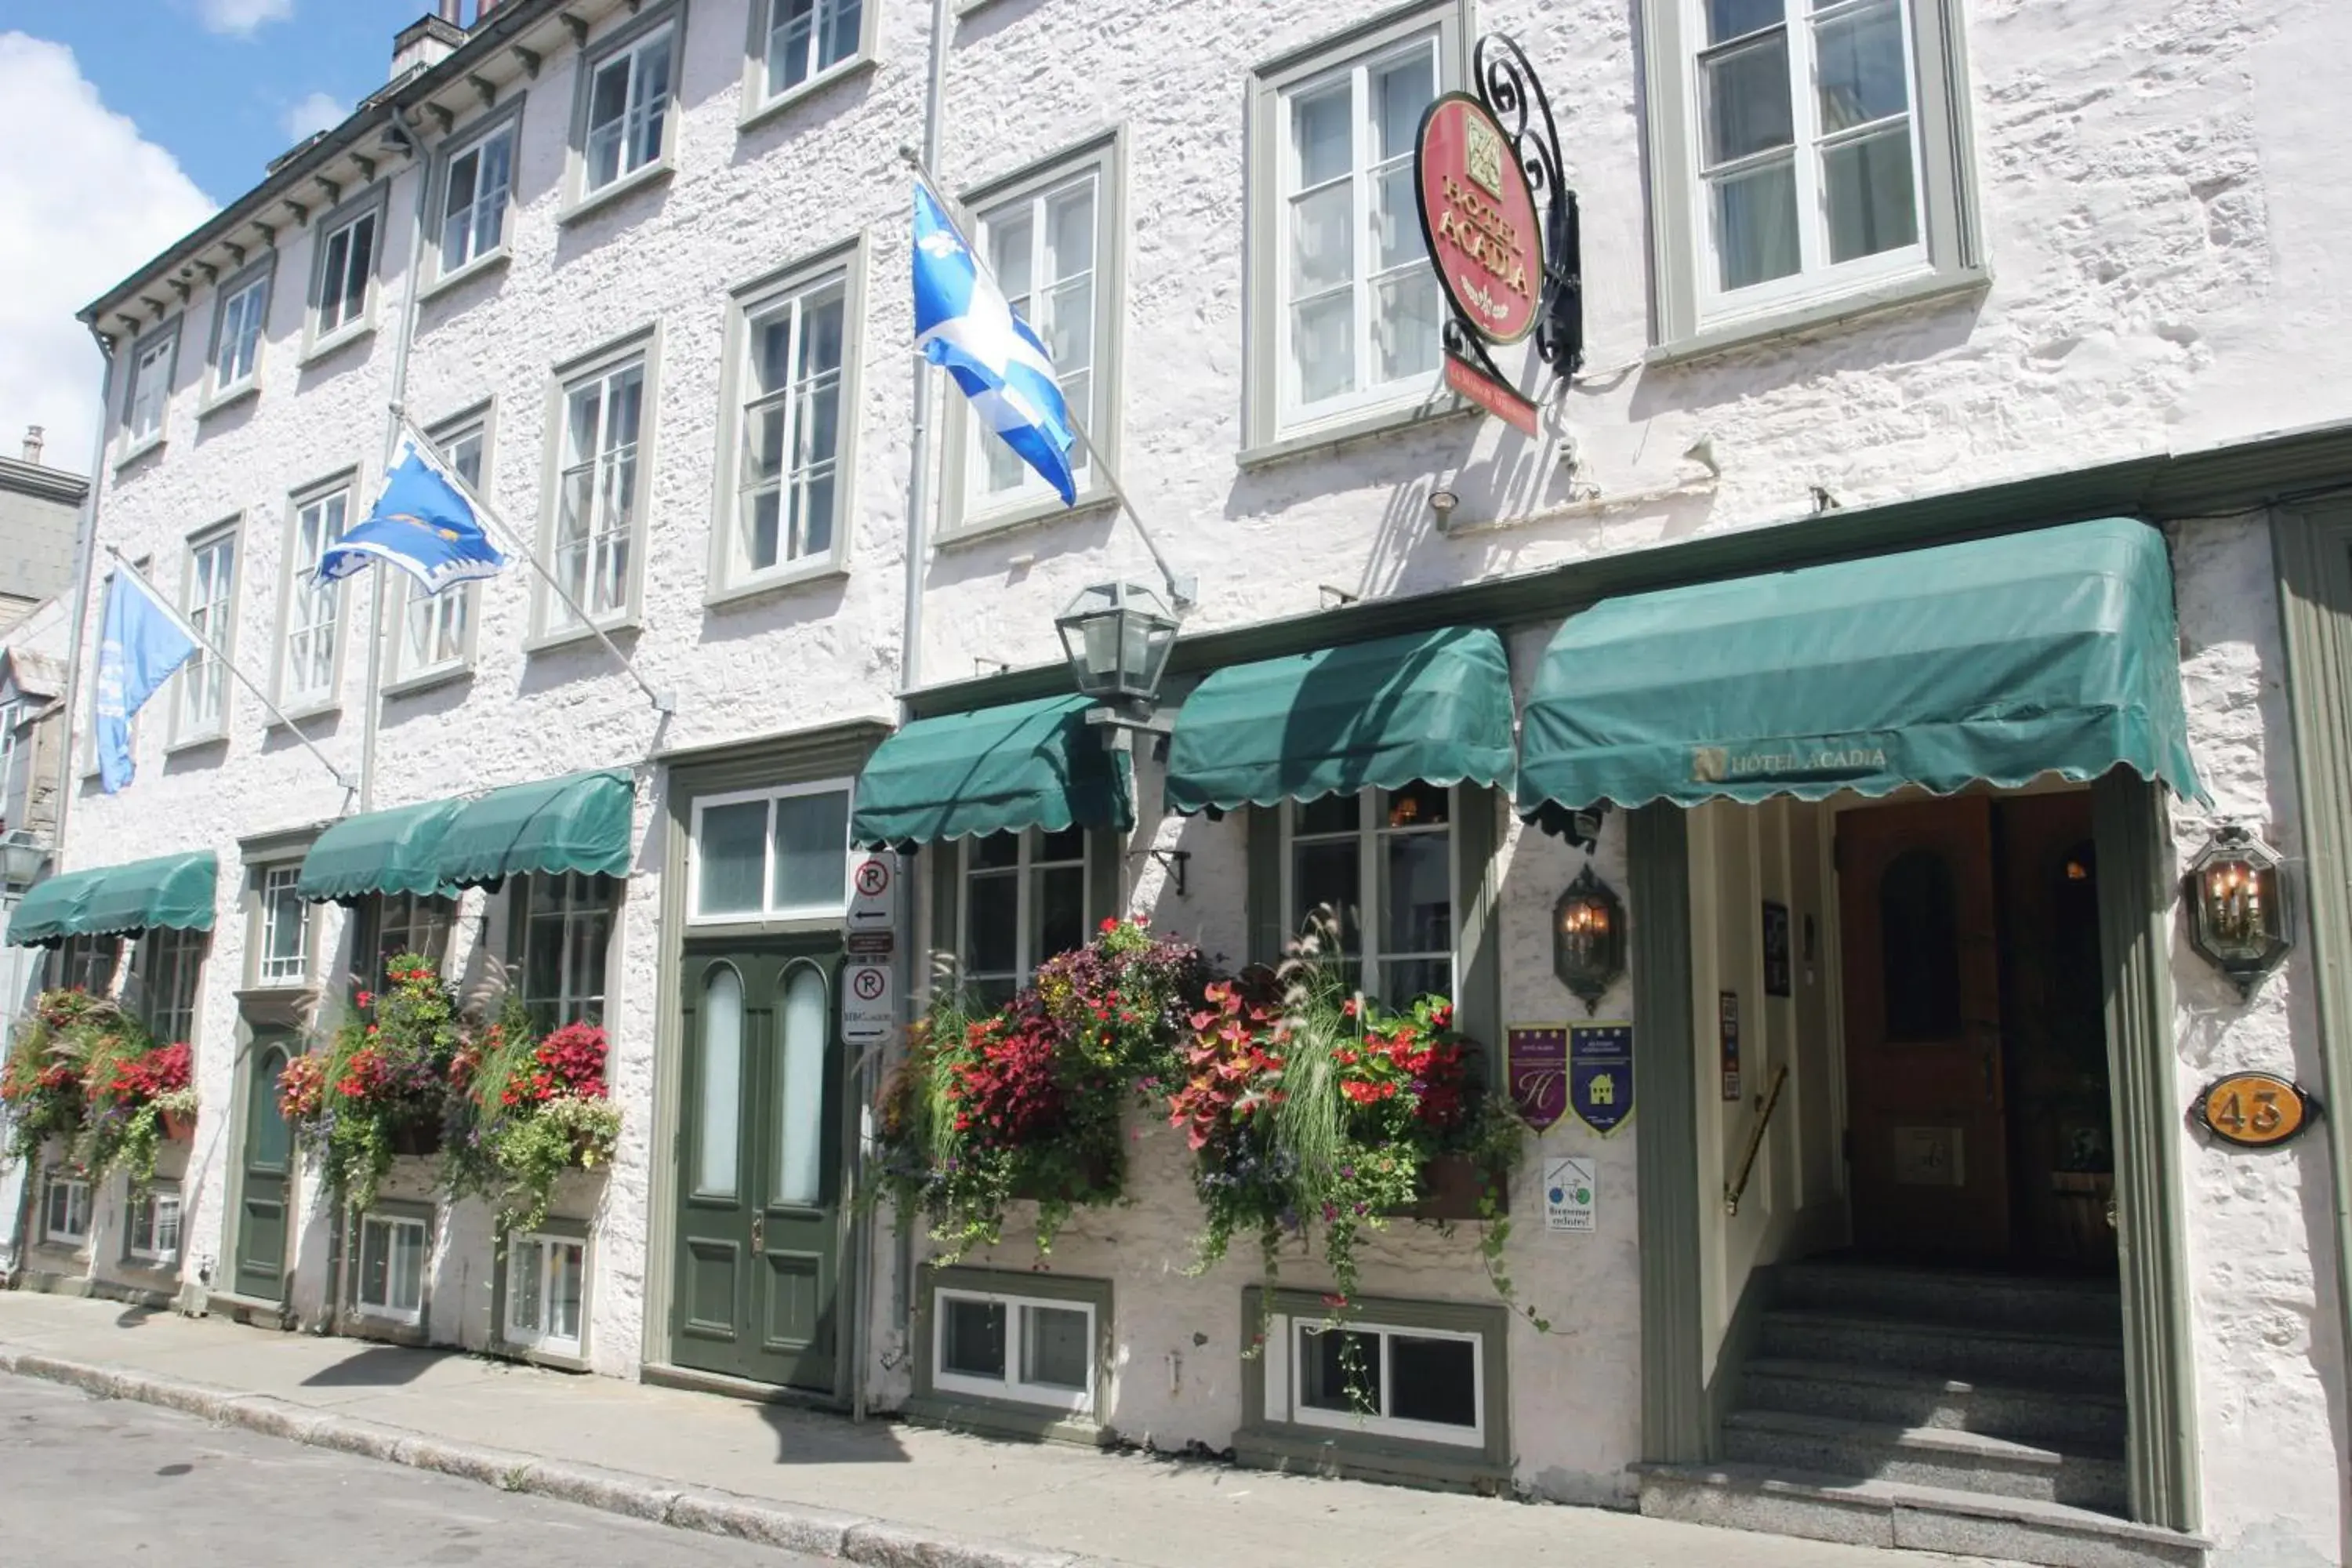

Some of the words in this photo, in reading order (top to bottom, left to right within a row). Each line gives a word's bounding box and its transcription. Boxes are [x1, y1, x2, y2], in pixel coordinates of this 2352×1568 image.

[1443, 175, 1525, 256] HÔTEL
[1438, 209, 1529, 299] ACADIA
[1804, 748, 1886, 769] ACADIA
[2216, 1089, 2282, 1134] 43
